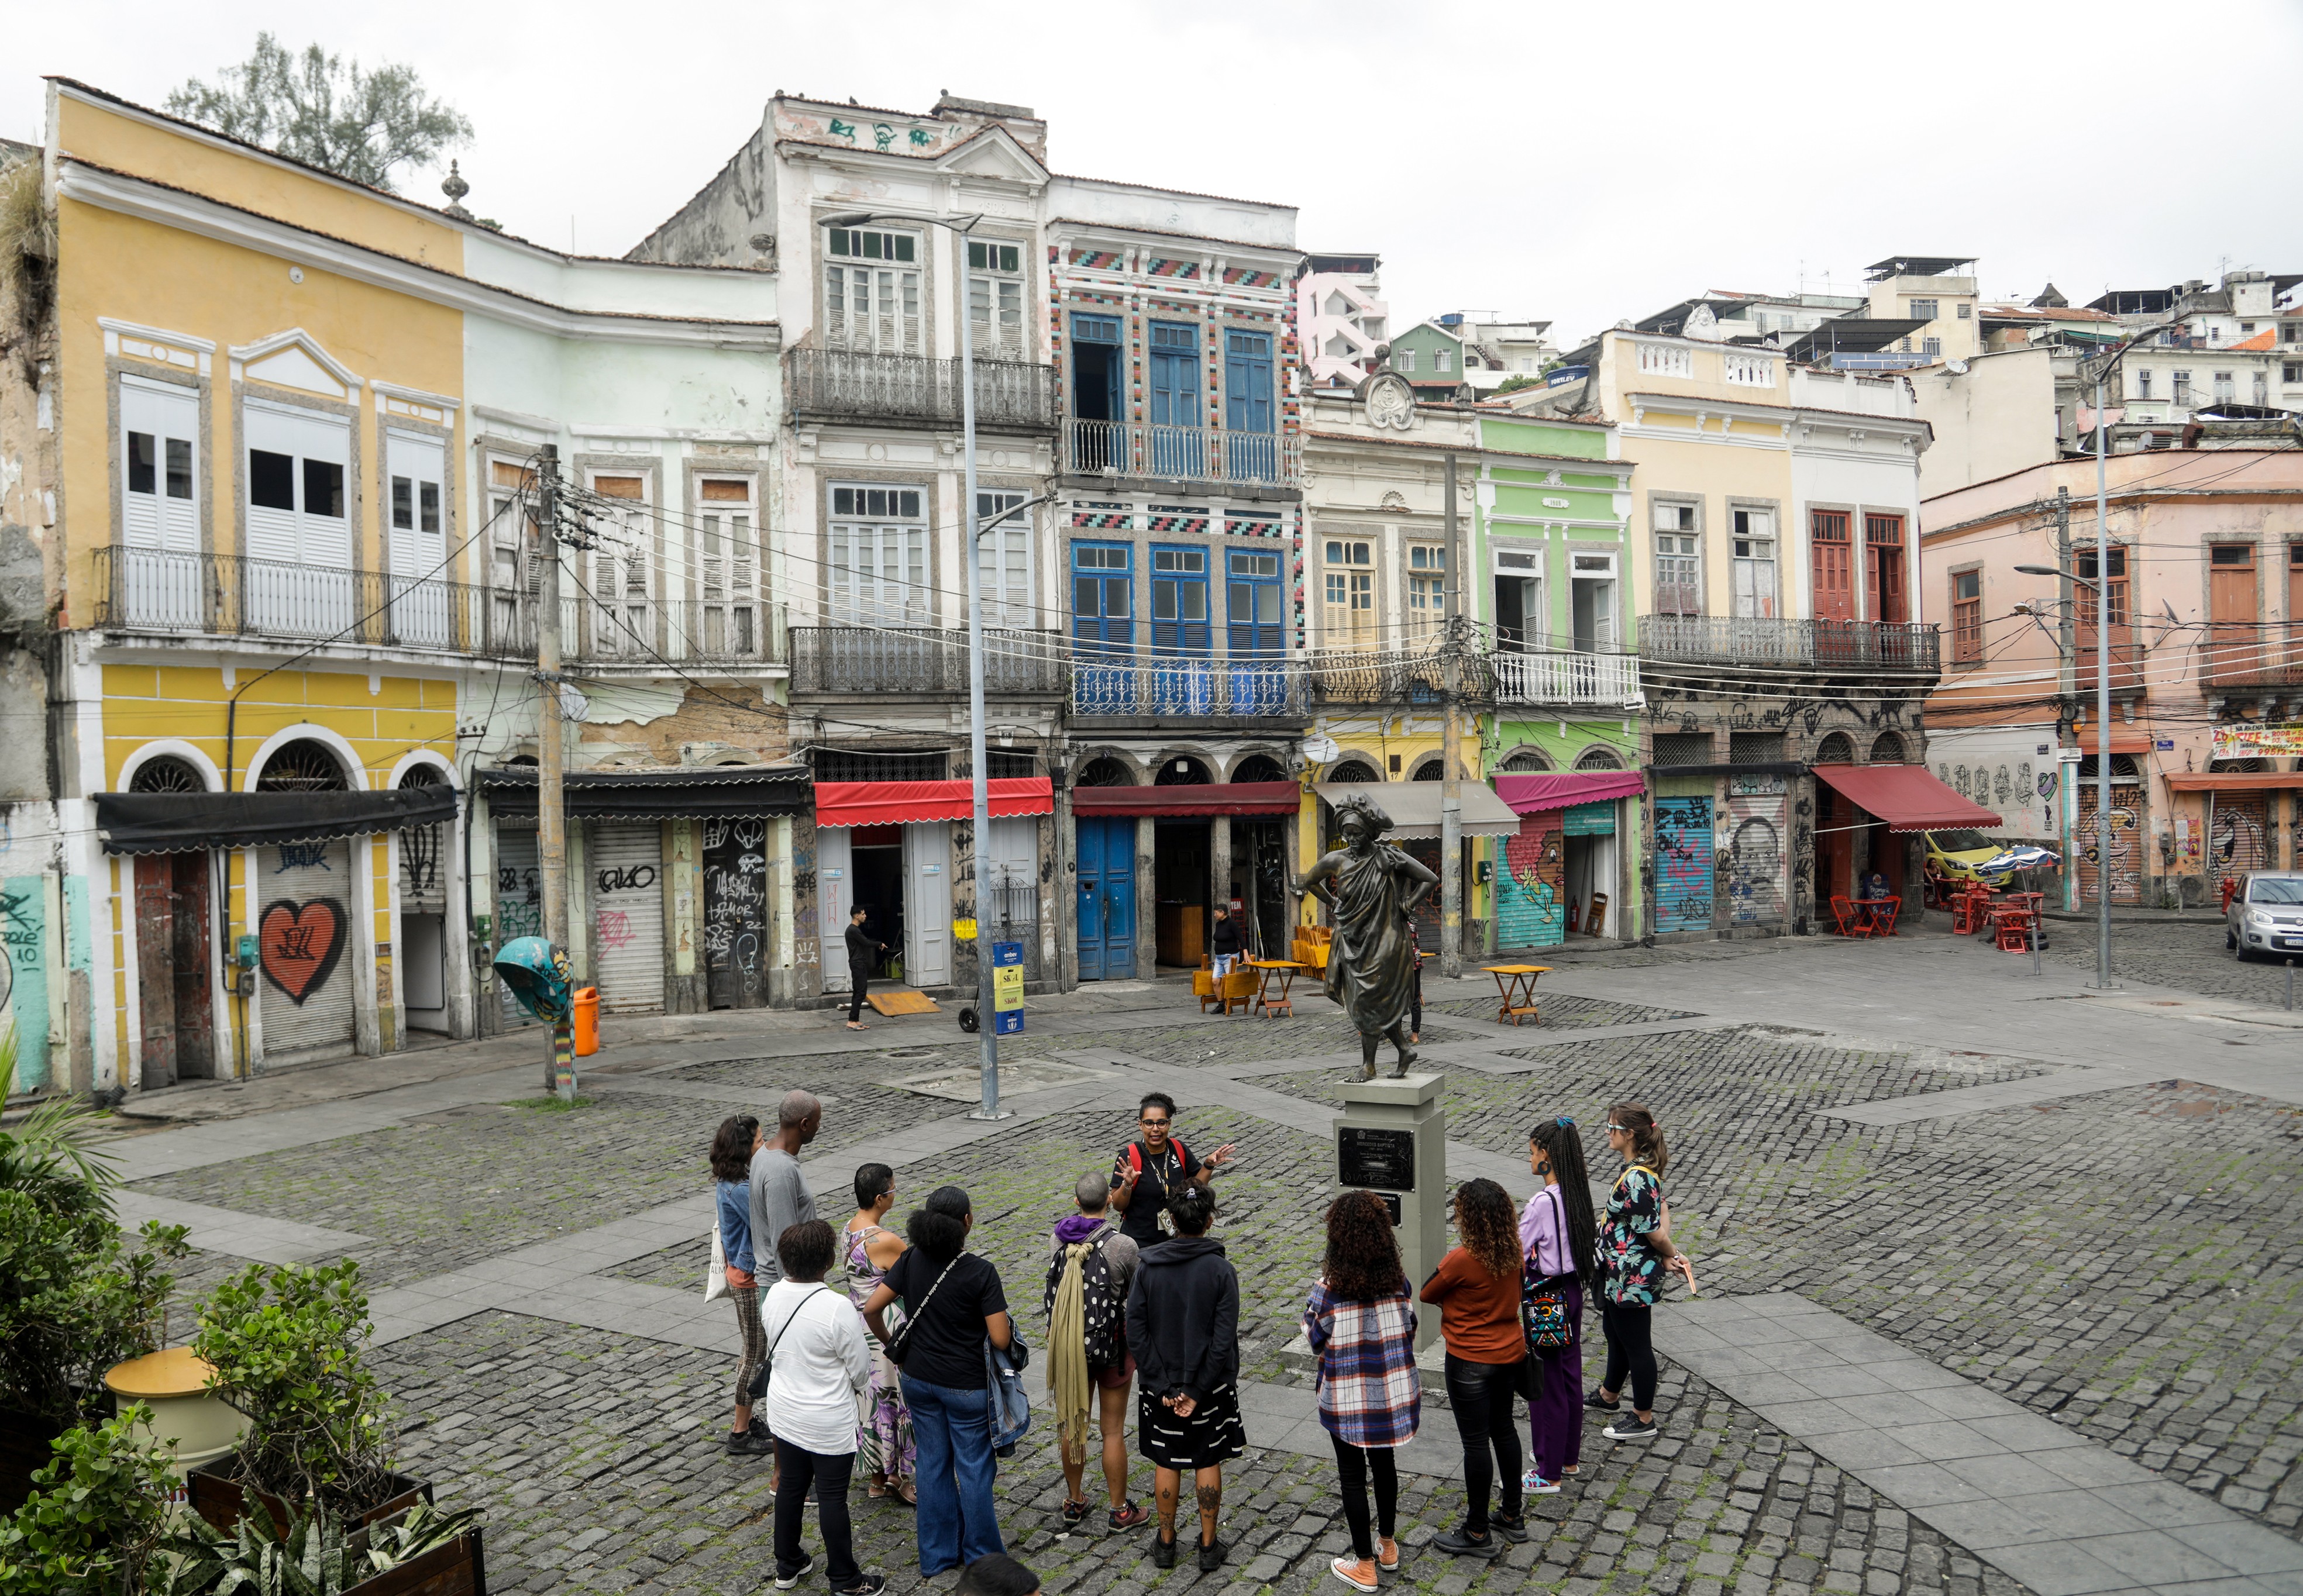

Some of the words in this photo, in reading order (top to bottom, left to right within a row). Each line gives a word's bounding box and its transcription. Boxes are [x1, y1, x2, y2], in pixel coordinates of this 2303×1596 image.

[978, 201, 1006, 213] 1908
[2214, 729, 2229, 742] 28
[1391, 772, 1399, 780] 17
[1231, 901, 1241, 909] TEM
[1003, 974, 1018, 983] SKOL
[1004, 997, 1018, 1005] SKOL
[711, 1253, 724, 1264] ÁGU
[711, 1265, 726, 1274] ALM
